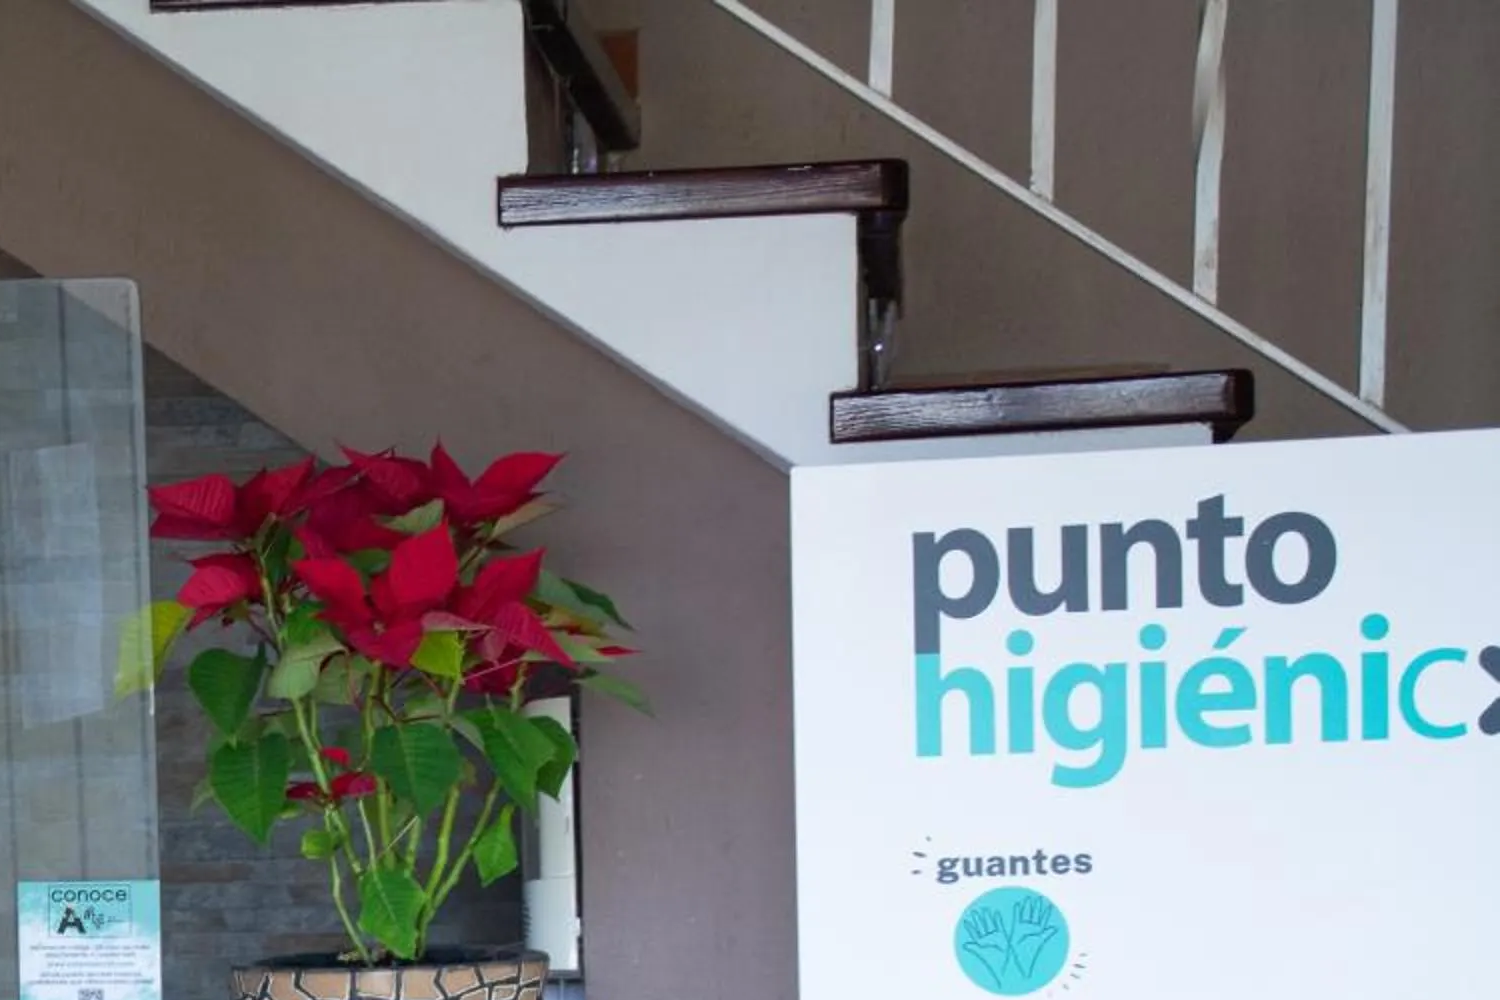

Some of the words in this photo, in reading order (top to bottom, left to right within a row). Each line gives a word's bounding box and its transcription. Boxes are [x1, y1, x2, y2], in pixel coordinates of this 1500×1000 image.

[912, 494, 1337, 655] punto
[914, 612, 1500, 789] higiénic
[51, 889, 127, 902] conoce
[936, 849, 1093, 884] guantes
